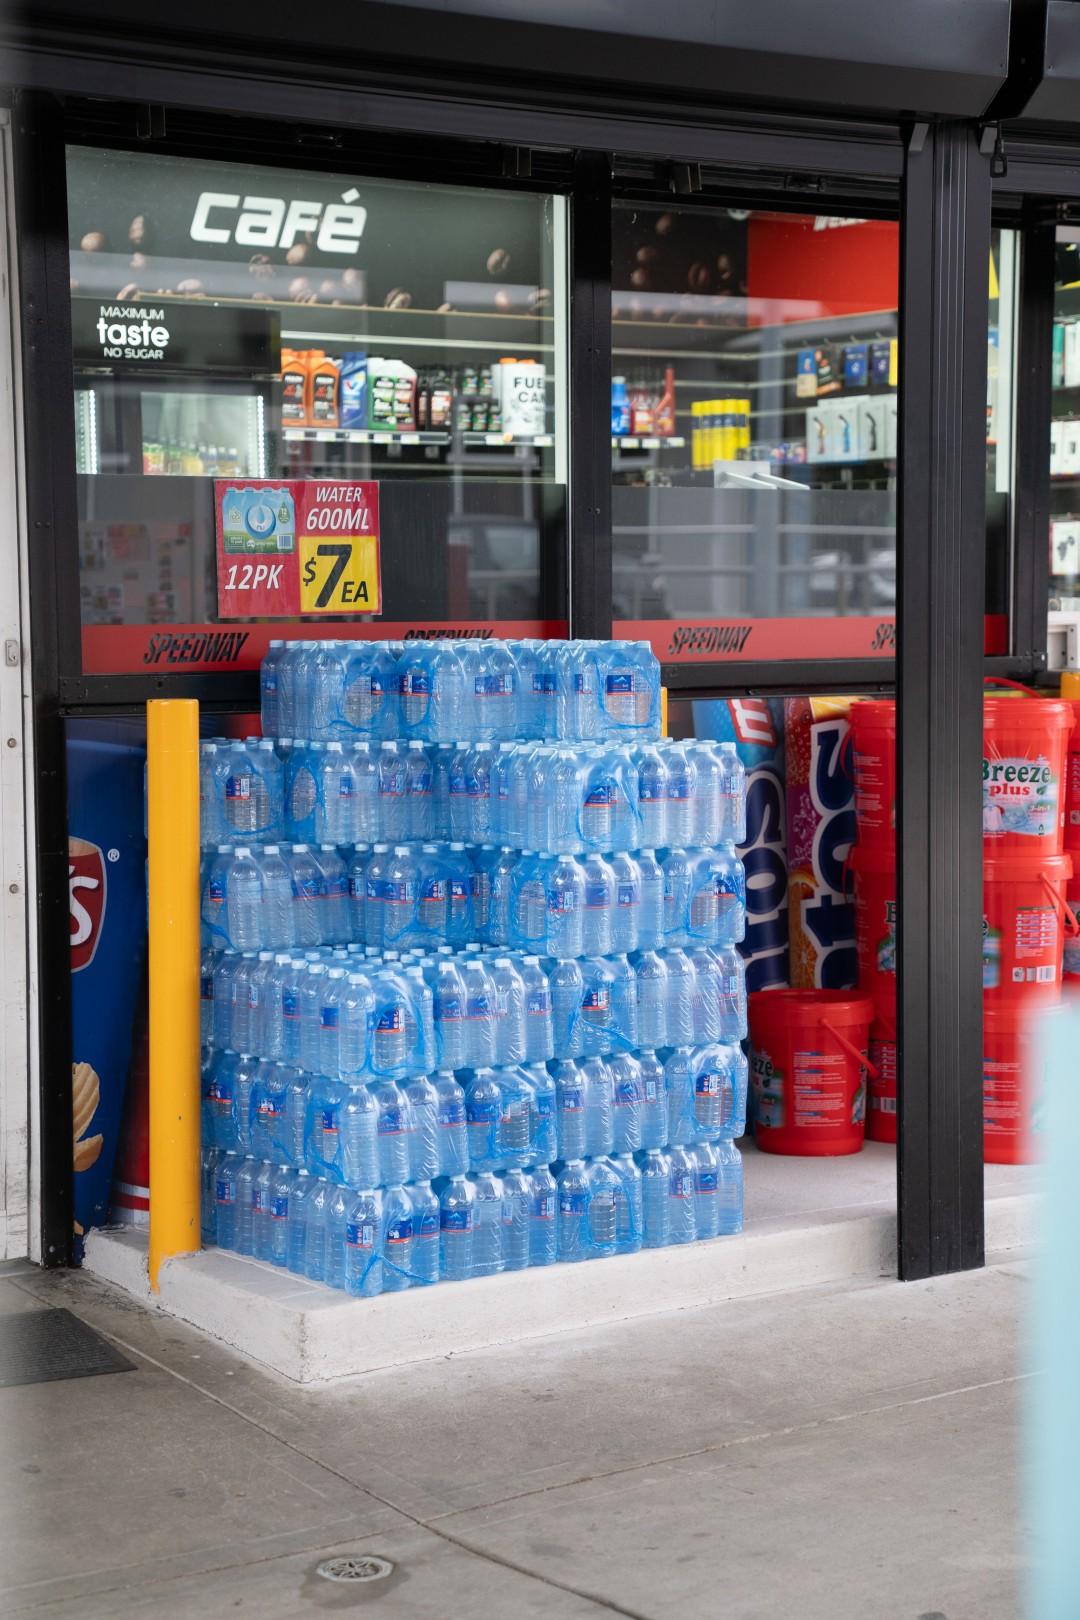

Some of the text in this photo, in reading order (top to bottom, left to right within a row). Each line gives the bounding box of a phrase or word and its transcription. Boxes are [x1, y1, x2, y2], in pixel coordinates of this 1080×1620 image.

[100, 306, 165, 321] MAXIMUM
[97, 317, 170, 348] taste
[103, 347, 164, 360] NO SUGAR
[316, 486, 362, 503] WATER
[306, 507, 370, 530] 600ML
[224, 563, 285, 591] 12PK
[341, 581, 369, 603] EA
[143, 632, 249, 664] SPEEDWAY
[668, 626, 752, 655] SPEEDWAY
[988, 783, 1031, 797] plus
